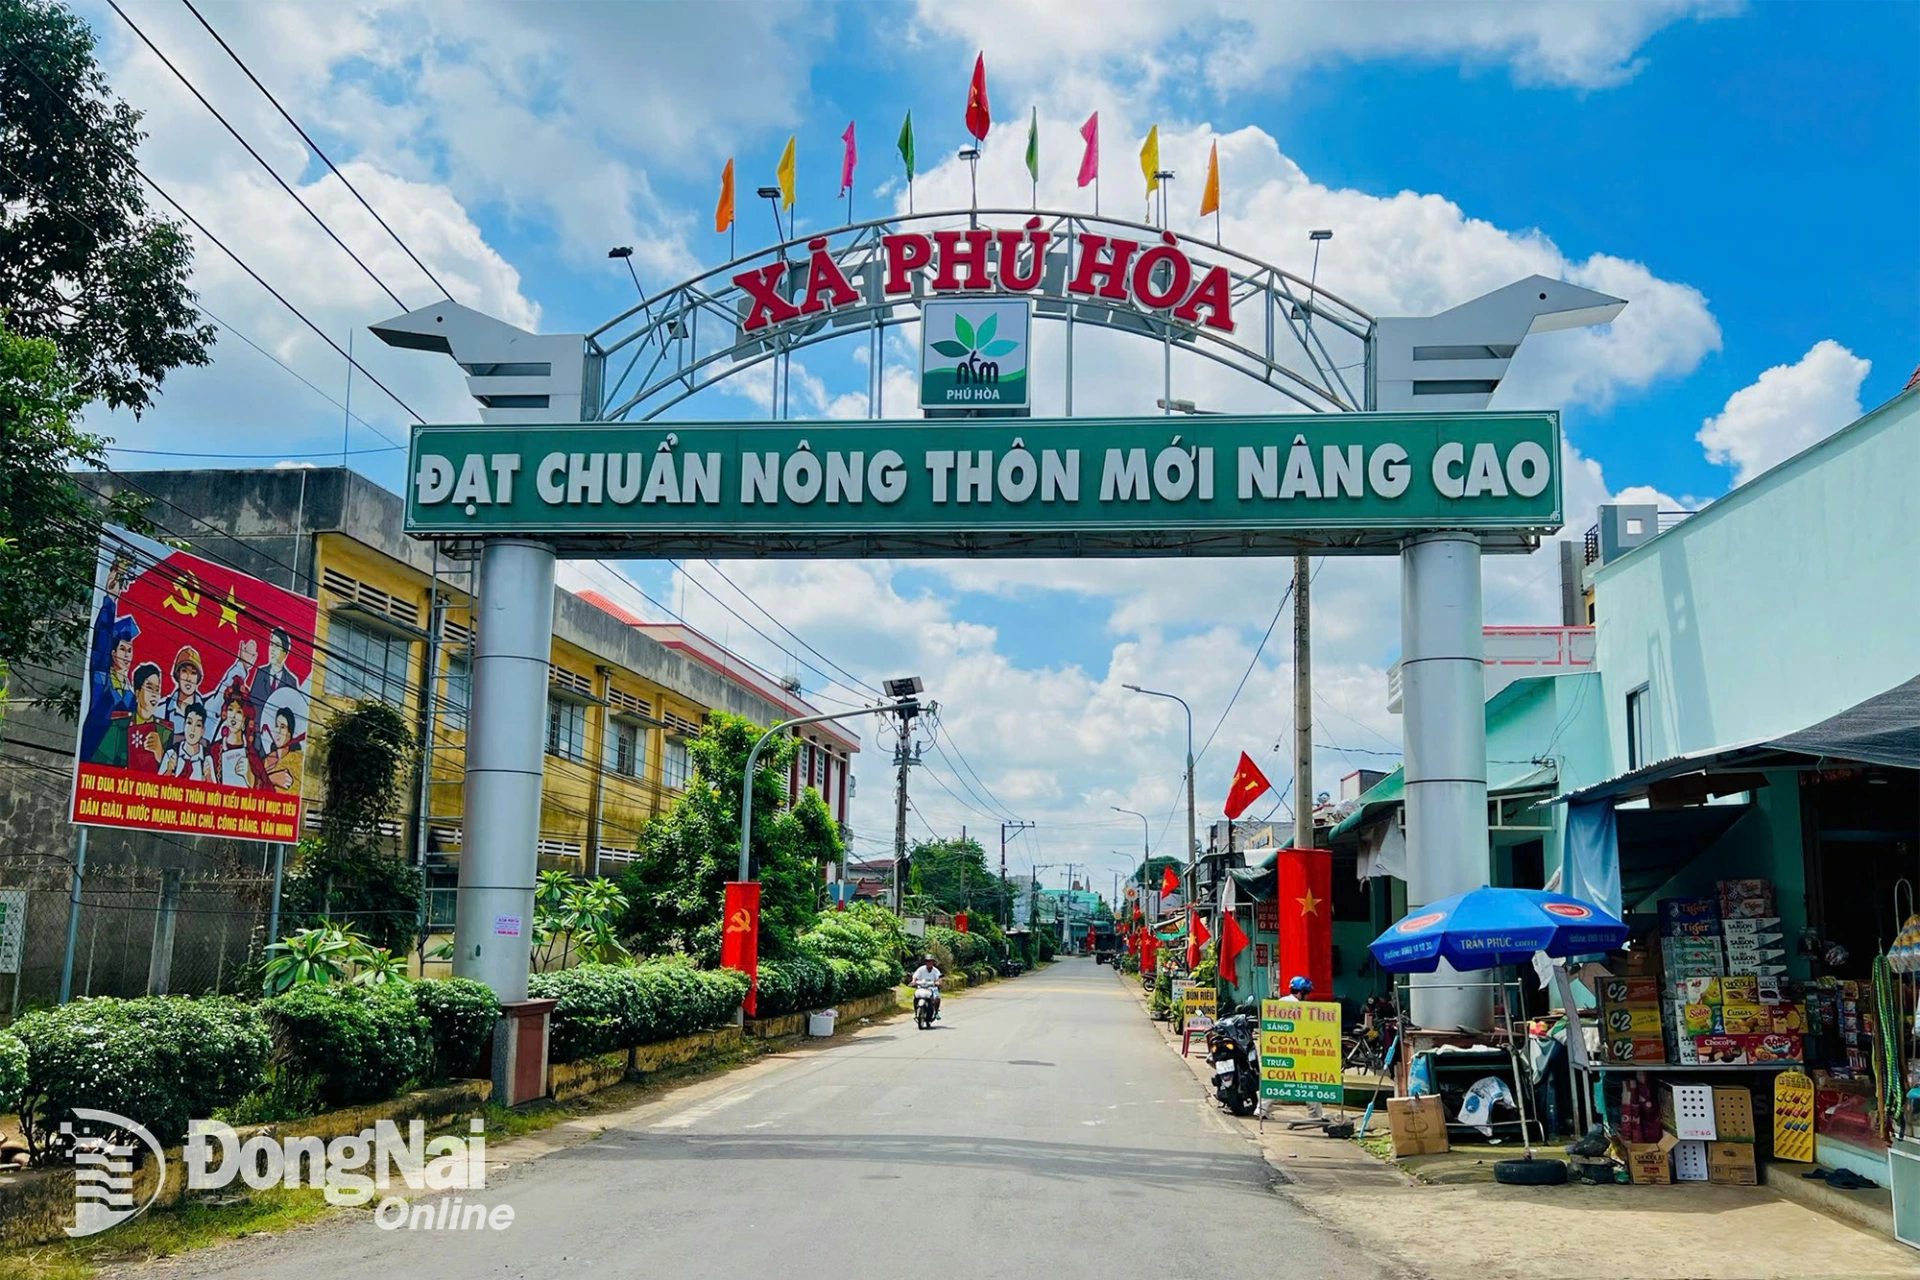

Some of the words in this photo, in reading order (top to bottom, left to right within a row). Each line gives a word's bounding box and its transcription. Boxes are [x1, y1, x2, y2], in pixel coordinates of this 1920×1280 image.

[732, 236, 862, 335] XÃ
[881, 216, 1052, 296] PHÚ
[1068, 230, 1237, 335] HÒA
[946, 387, 972, 400] PHÚ
[974, 387, 1000, 400] HÒA
[416, 452, 520, 515] ĐẠT
[536, 432, 721, 504] CHUẨN
[741, 438, 907, 504] NÔNG
[926, 437, 1080, 502] THÔN
[1100, 434, 1214, 501] MỚI
[1238, 433, 1410, 500] NÂNG
[1432, 440, 1550, 498] CAO
[81, 774, 95, 789] THI
[98, 776, 114, 792] ĐUA
[116, 778, 134, 795] XÂY
[136, 782, 159, 800] DỰNG
[161, 784, 184, 802] NÔNG
[186, 787, 205, 804] THÔN
[206, 790, 222, 806] MỚI
[258, 797, 266, 812] VÌ
[266, 800, 282, 816] MỤC
[282, 800, 297, 817] TIÊU
[80, 800, 99, 816] DÂN
[101, 800, 124, 820] GIÀU,
[126, 804, 150, 821] NƯỚC
[152, 808, 178, 827] MẠNH,
[180, 810, 197, 826] DÂN
[198, 812, 216, 830] CHỦ,
[216, 814, 237, 832] CÔNG
[260, 820, 275, 836] VĂN
[276, 822, 294, 837] MINH
[1680, 902, 1708, 916] Tiger
[1682, 923, 1710, 934] Tiger
[1460, 934, 1484, 950] TRẦN
[1486, 934, 1512, 948] PHÚC
[1186, 989, 1198, 1000] BÚN
[1200, 990, 1214, 1000] RIÊU
[1607, 983, 1627, 1002] C2
[1267, 1005, 1302, 1020] Hoài
[1689, 1009, 1710, 1018] Solite
[1267, 1023, 1292, 1031] SÁNG:
[1610, 1012, 1631, 1031] C2
[1270, 1035, 1299, 1046] CƠM
[1303, 1035, 1332, 1048] TẤM
[1613, 1040, 1634, 1060] C2
[1267, 1069, 1296, 1081] CƠM
[1301, 1071, 1336, 1083] TRƯA
[1266, 1088, 1291, 1096] 0364
[1317, 1091, 1336, 1099] 065
